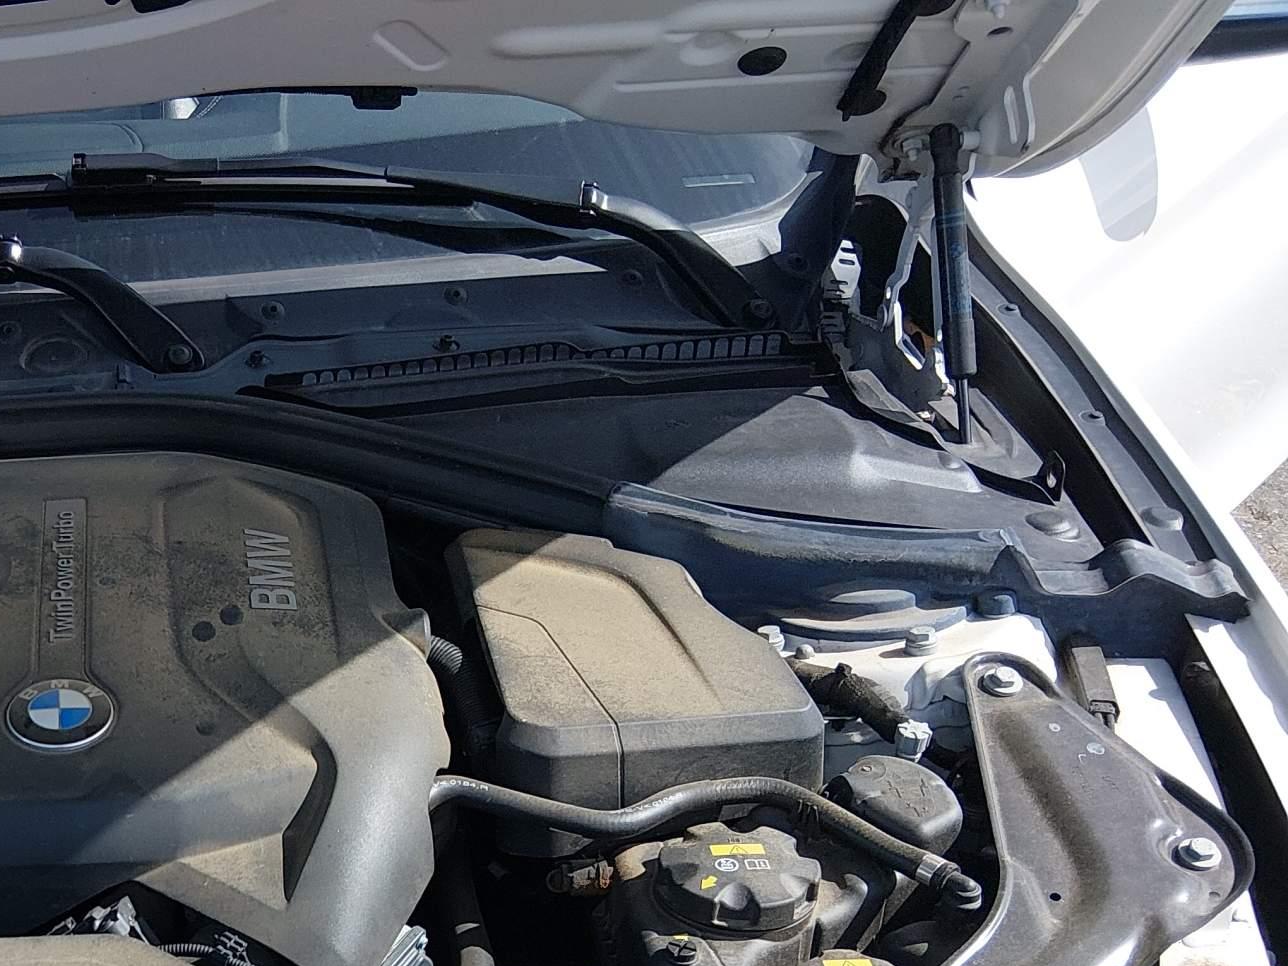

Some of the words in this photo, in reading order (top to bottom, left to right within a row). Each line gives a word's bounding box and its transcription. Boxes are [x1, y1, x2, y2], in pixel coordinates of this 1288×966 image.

[48, 510, 75, 645] TwinPowerTurbo
[243, 528, 298, 611] BMW
[18, 679, 105, 700] BMW
